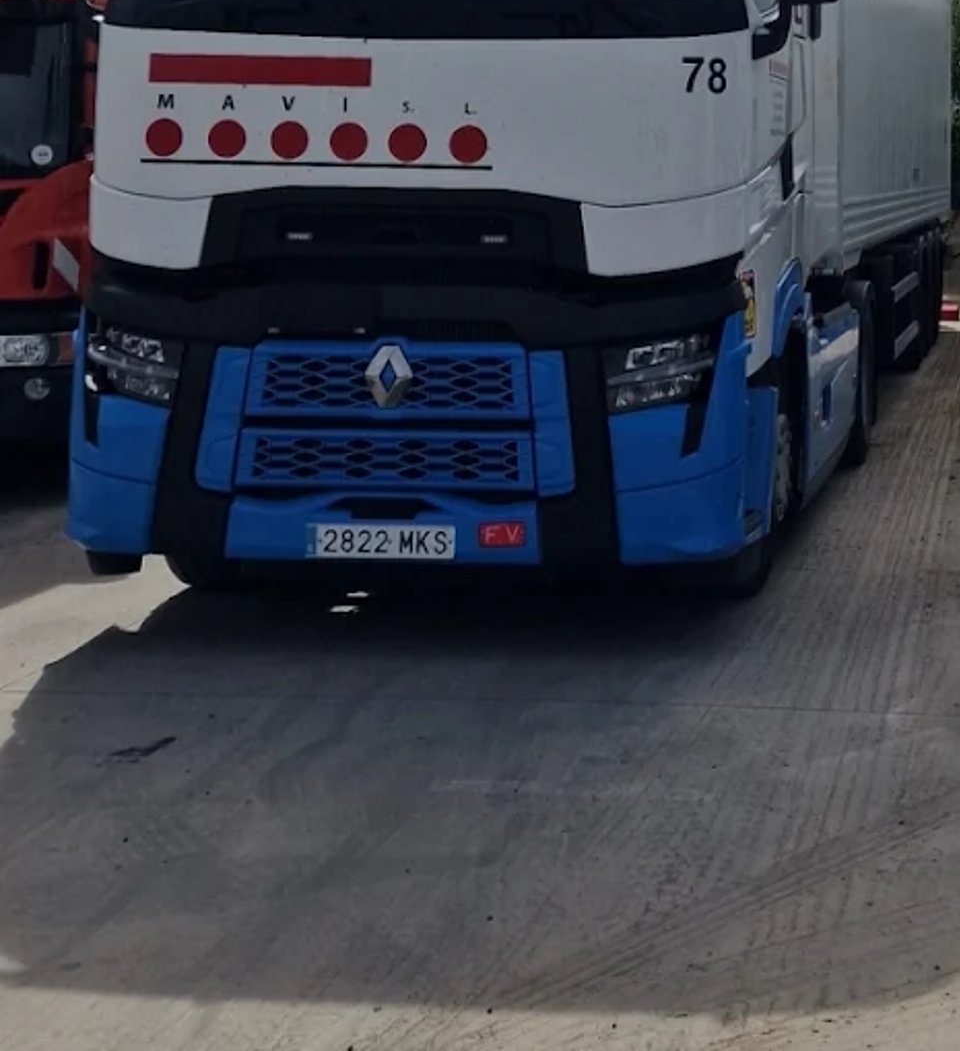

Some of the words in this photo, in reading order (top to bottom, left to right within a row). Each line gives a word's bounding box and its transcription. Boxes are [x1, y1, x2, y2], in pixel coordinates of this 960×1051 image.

[682, 57, 727, 94] 78
[323, 529, 388, 553] 2822
[400, 531, 448, 554] MKS
